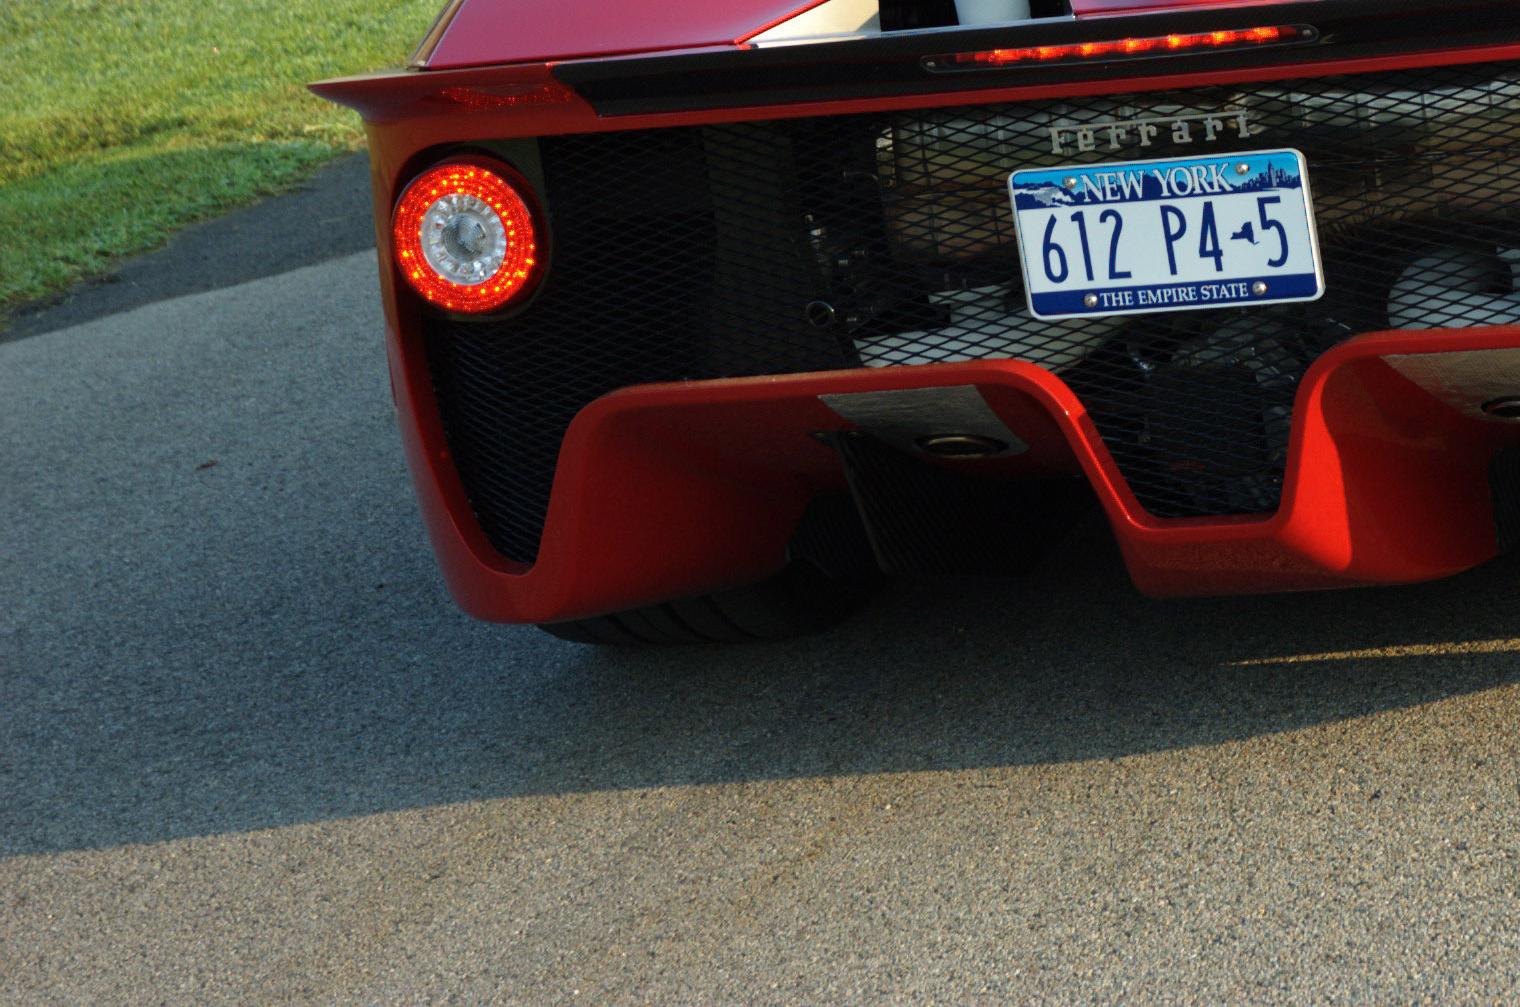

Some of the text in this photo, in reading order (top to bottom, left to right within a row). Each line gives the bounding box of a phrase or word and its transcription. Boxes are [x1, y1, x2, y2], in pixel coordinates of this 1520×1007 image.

[1050, 112, 1250, 154] Ferrari
[1079, 162, 1234, 203] NEW YORK
[1042, 209, 1132, 283] 612
[1099, 281, 1250, 307] THE EMPIRE STATE
